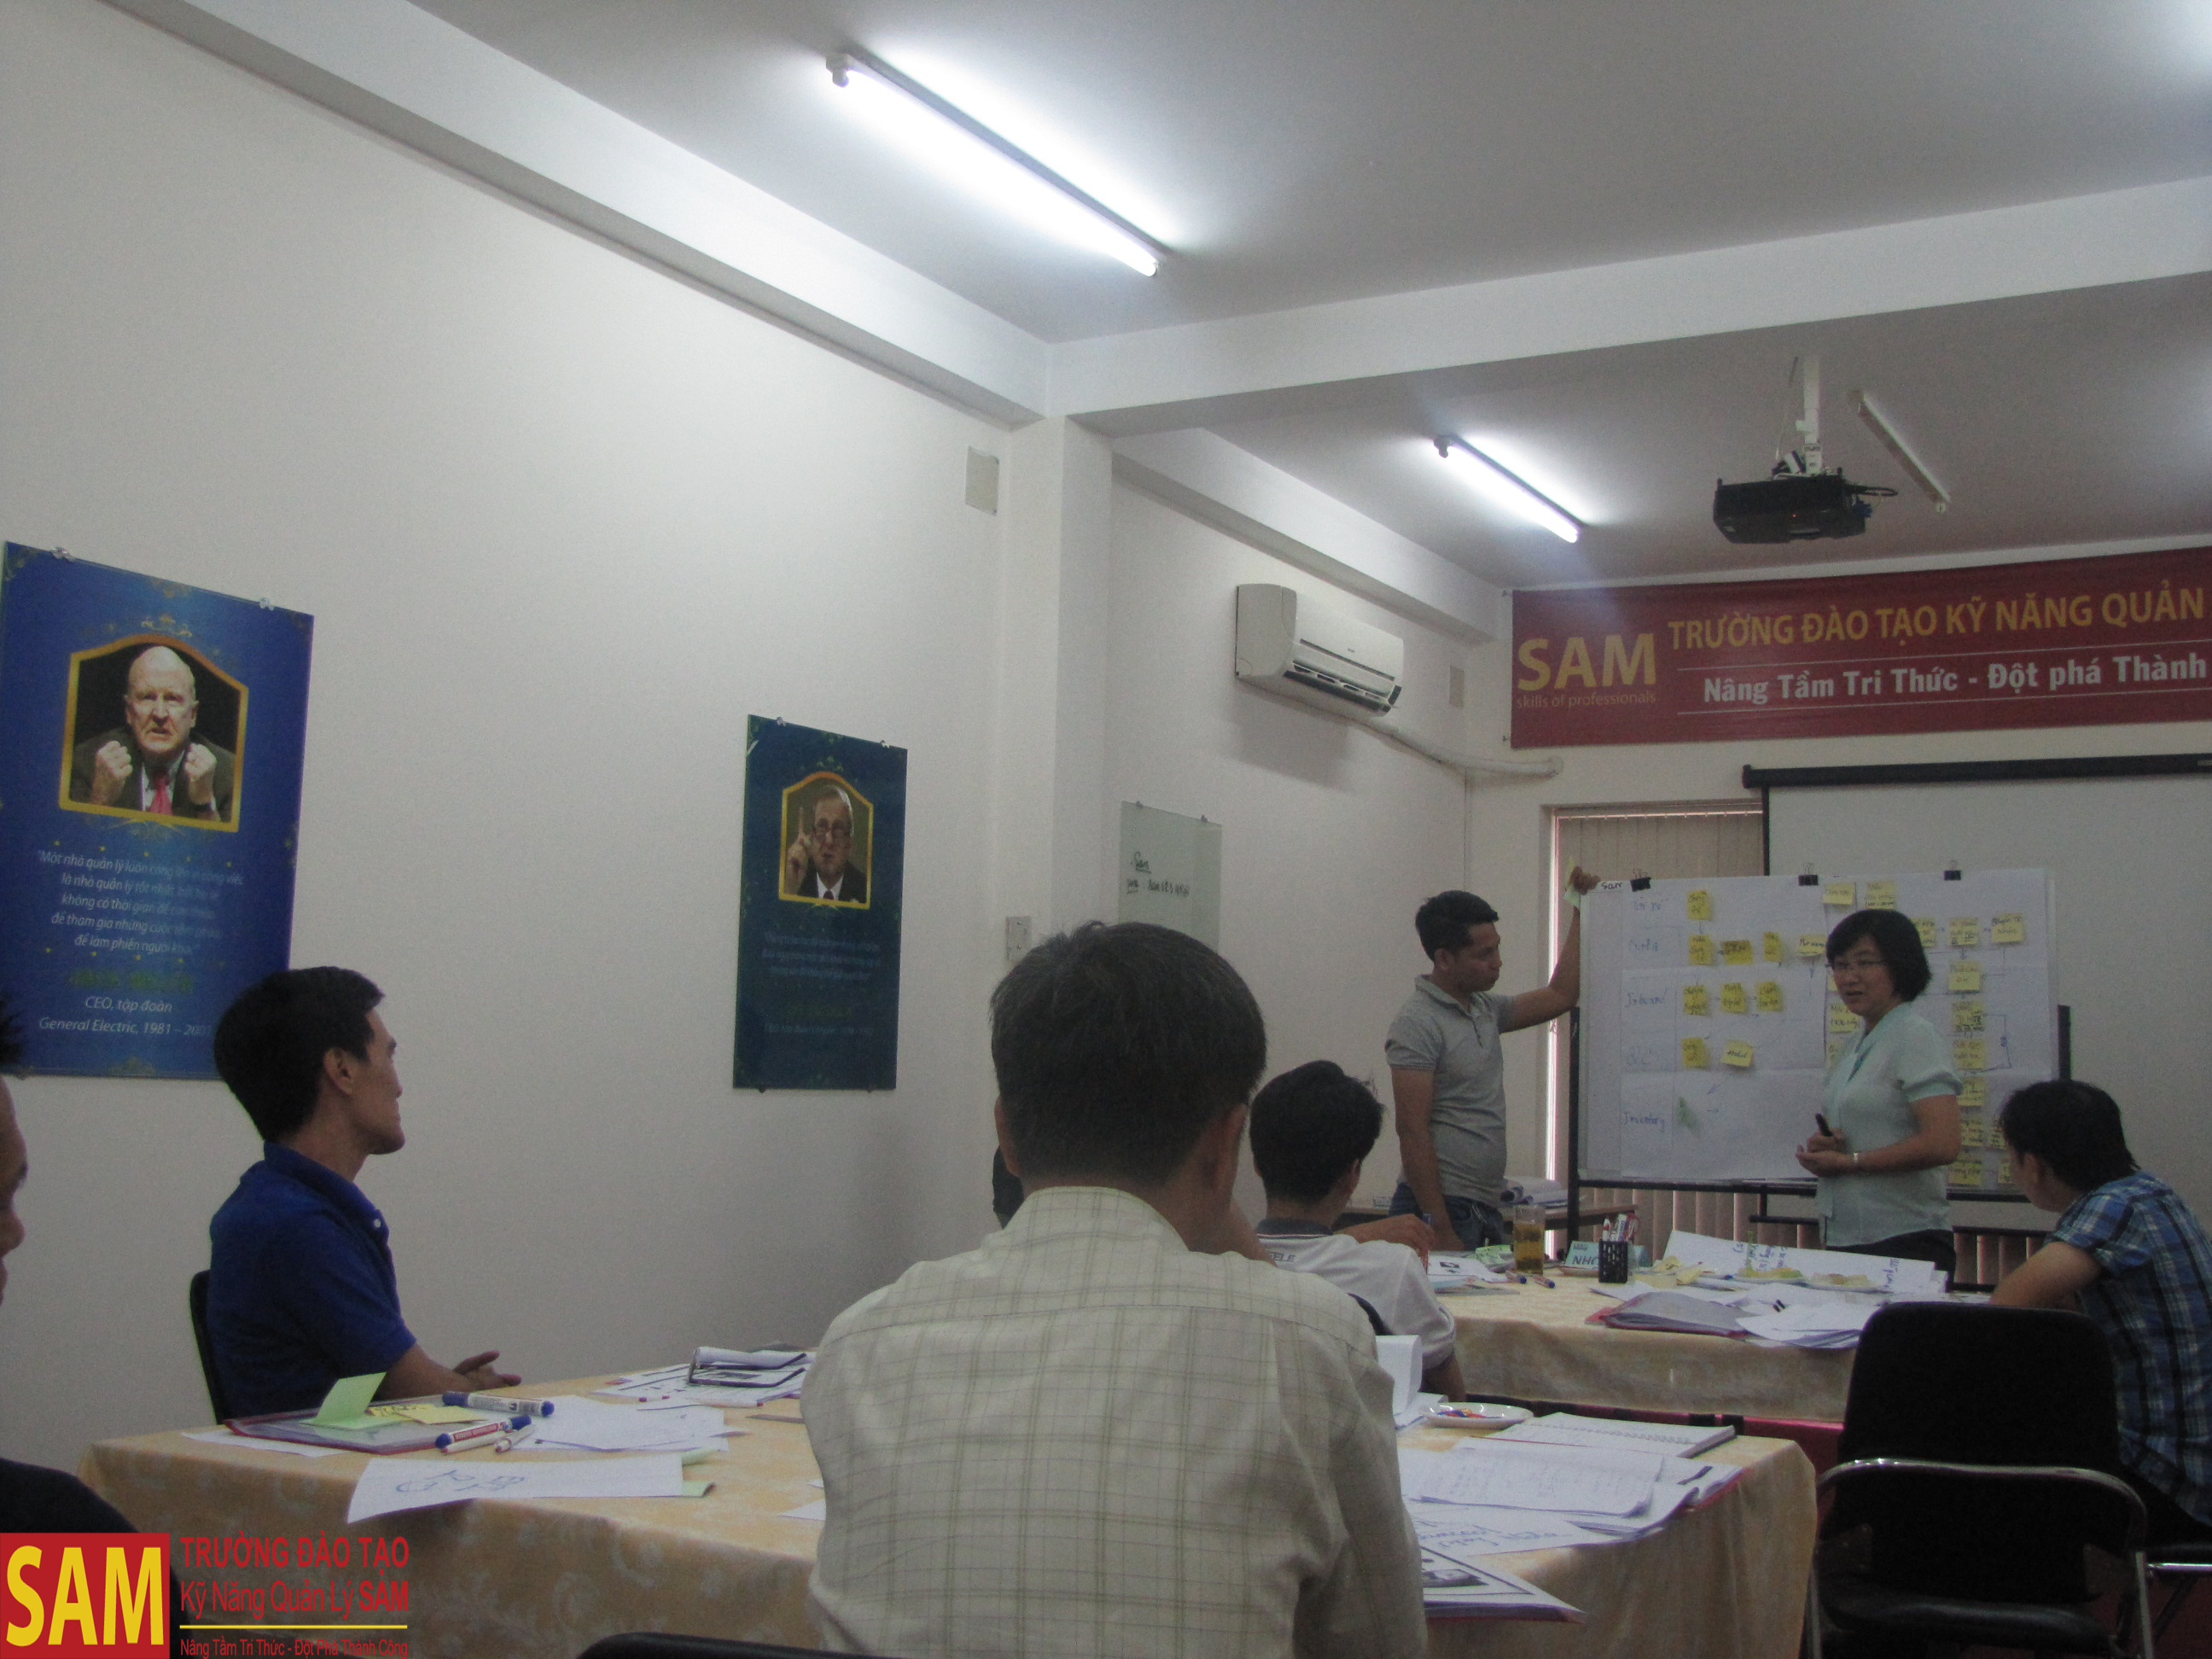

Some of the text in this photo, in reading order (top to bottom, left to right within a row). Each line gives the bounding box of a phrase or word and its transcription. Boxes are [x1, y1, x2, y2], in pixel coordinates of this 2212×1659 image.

[1668, 579, 2204, 649] TRƯỜNG ĐÀO TẠO KỸ NĂNG QUẢN
[1517, 633, 1656, 691] SAM
[1704, 677, 1769, 704] Nâng
[1777, 670, 1835, 699] Tầm
[1842, 669, 1883, 696] Tri
[1890, 667, 1959, 694] Thức
[1988, 661, 2039, 694] Đột
[2049, 657, 2102, 691] phá
[2112, 652, 2207, 684] Thành
[1517, 691, 1656, 708] skills of professionals
[84, 996, 172, 1013] CEO, tập đoàn
[38, 1016, 90, 1031] General
[91, 1018, 138, 1034] Electric,
[143, 1022, 172, 1035] 1981
